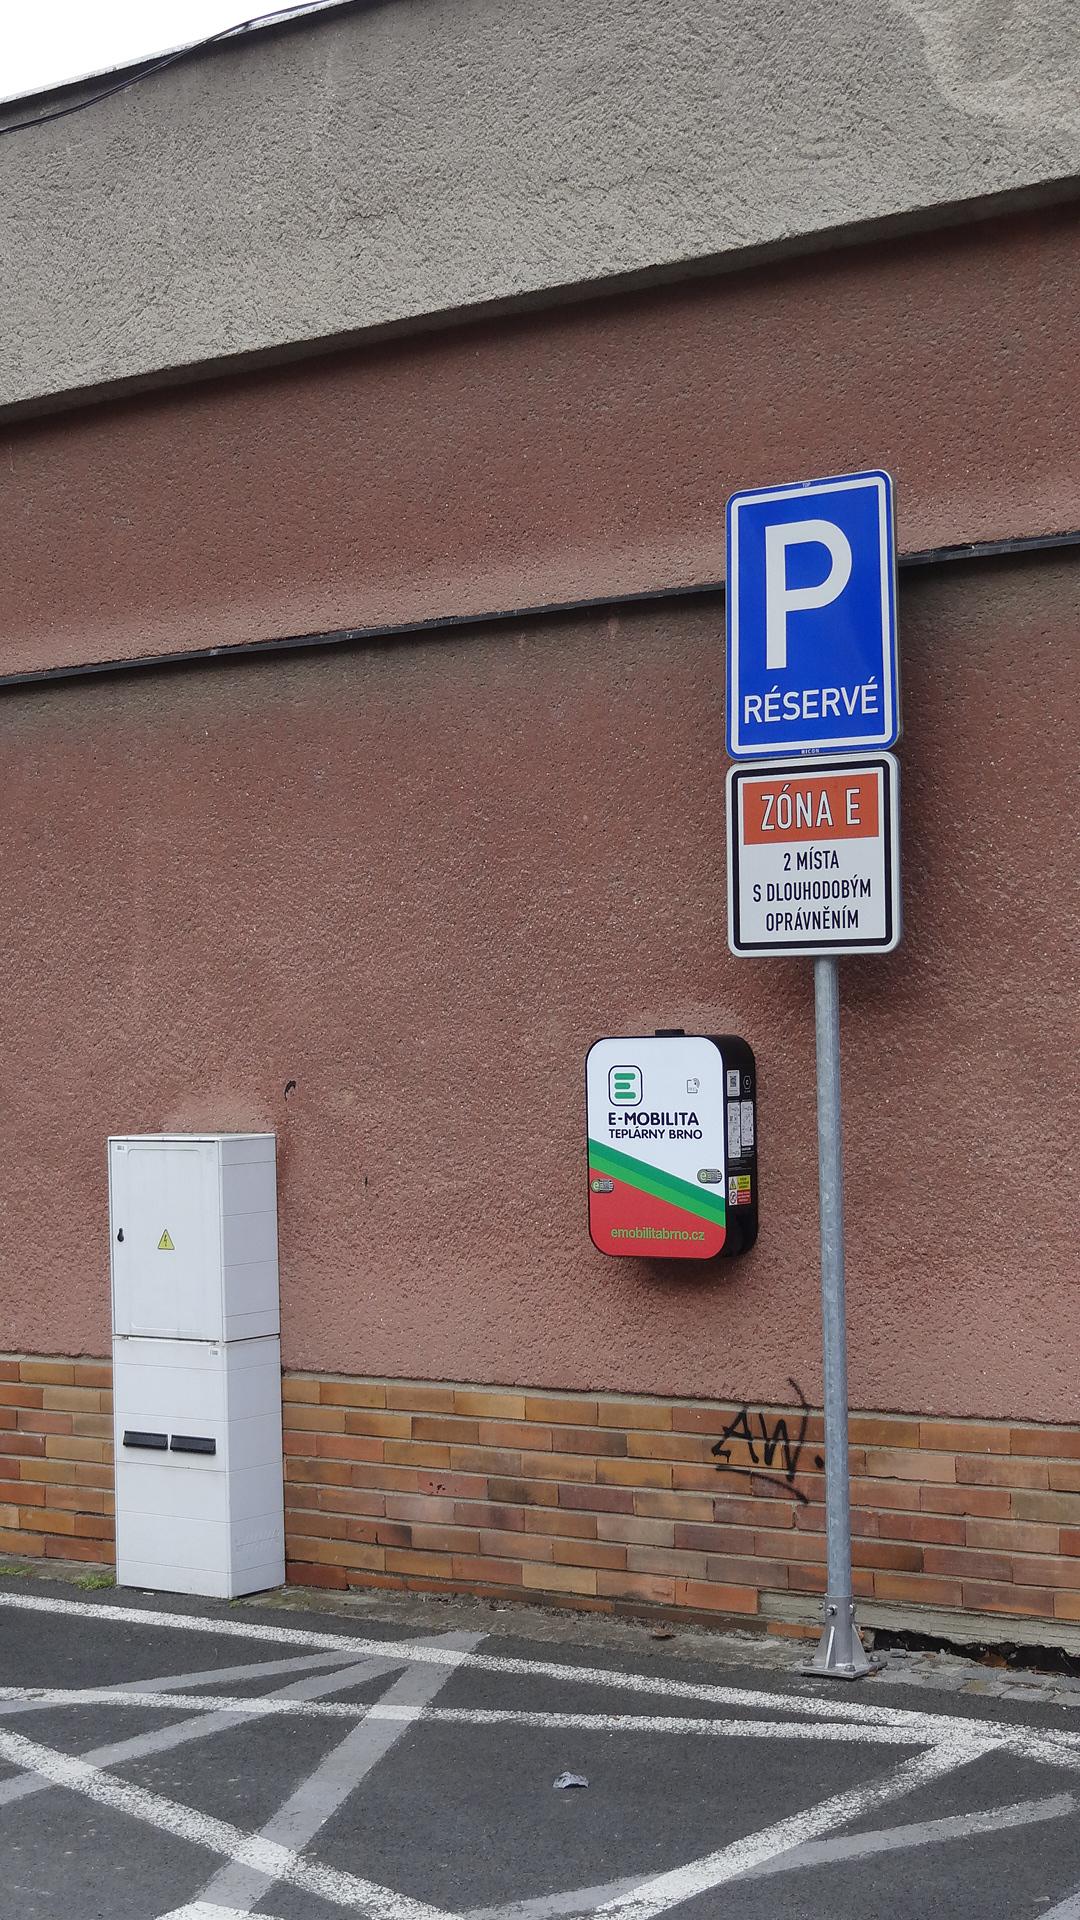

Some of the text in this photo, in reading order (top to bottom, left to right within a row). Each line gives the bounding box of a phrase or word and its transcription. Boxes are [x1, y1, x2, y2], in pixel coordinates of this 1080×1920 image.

[765, 519, 852, 670] P
[744, 676, 879, 724] RÉSERVÉ
[761, 783, 861, 831] ZÓNA E
[783, 846, 840, 871] 2 MÍSTA
[752, 874, 871, 903] S DLOUHODOBÝM
[766, 905, 859, 932] OPRÁVNĚNÍM
[608, 1111, 699, 1126] E-MOBILITA
[608, 1126, 703, 1140] TEPLÁRNY BRNO
[611, 1226, 705, 1241] emobilitabrno.cz
